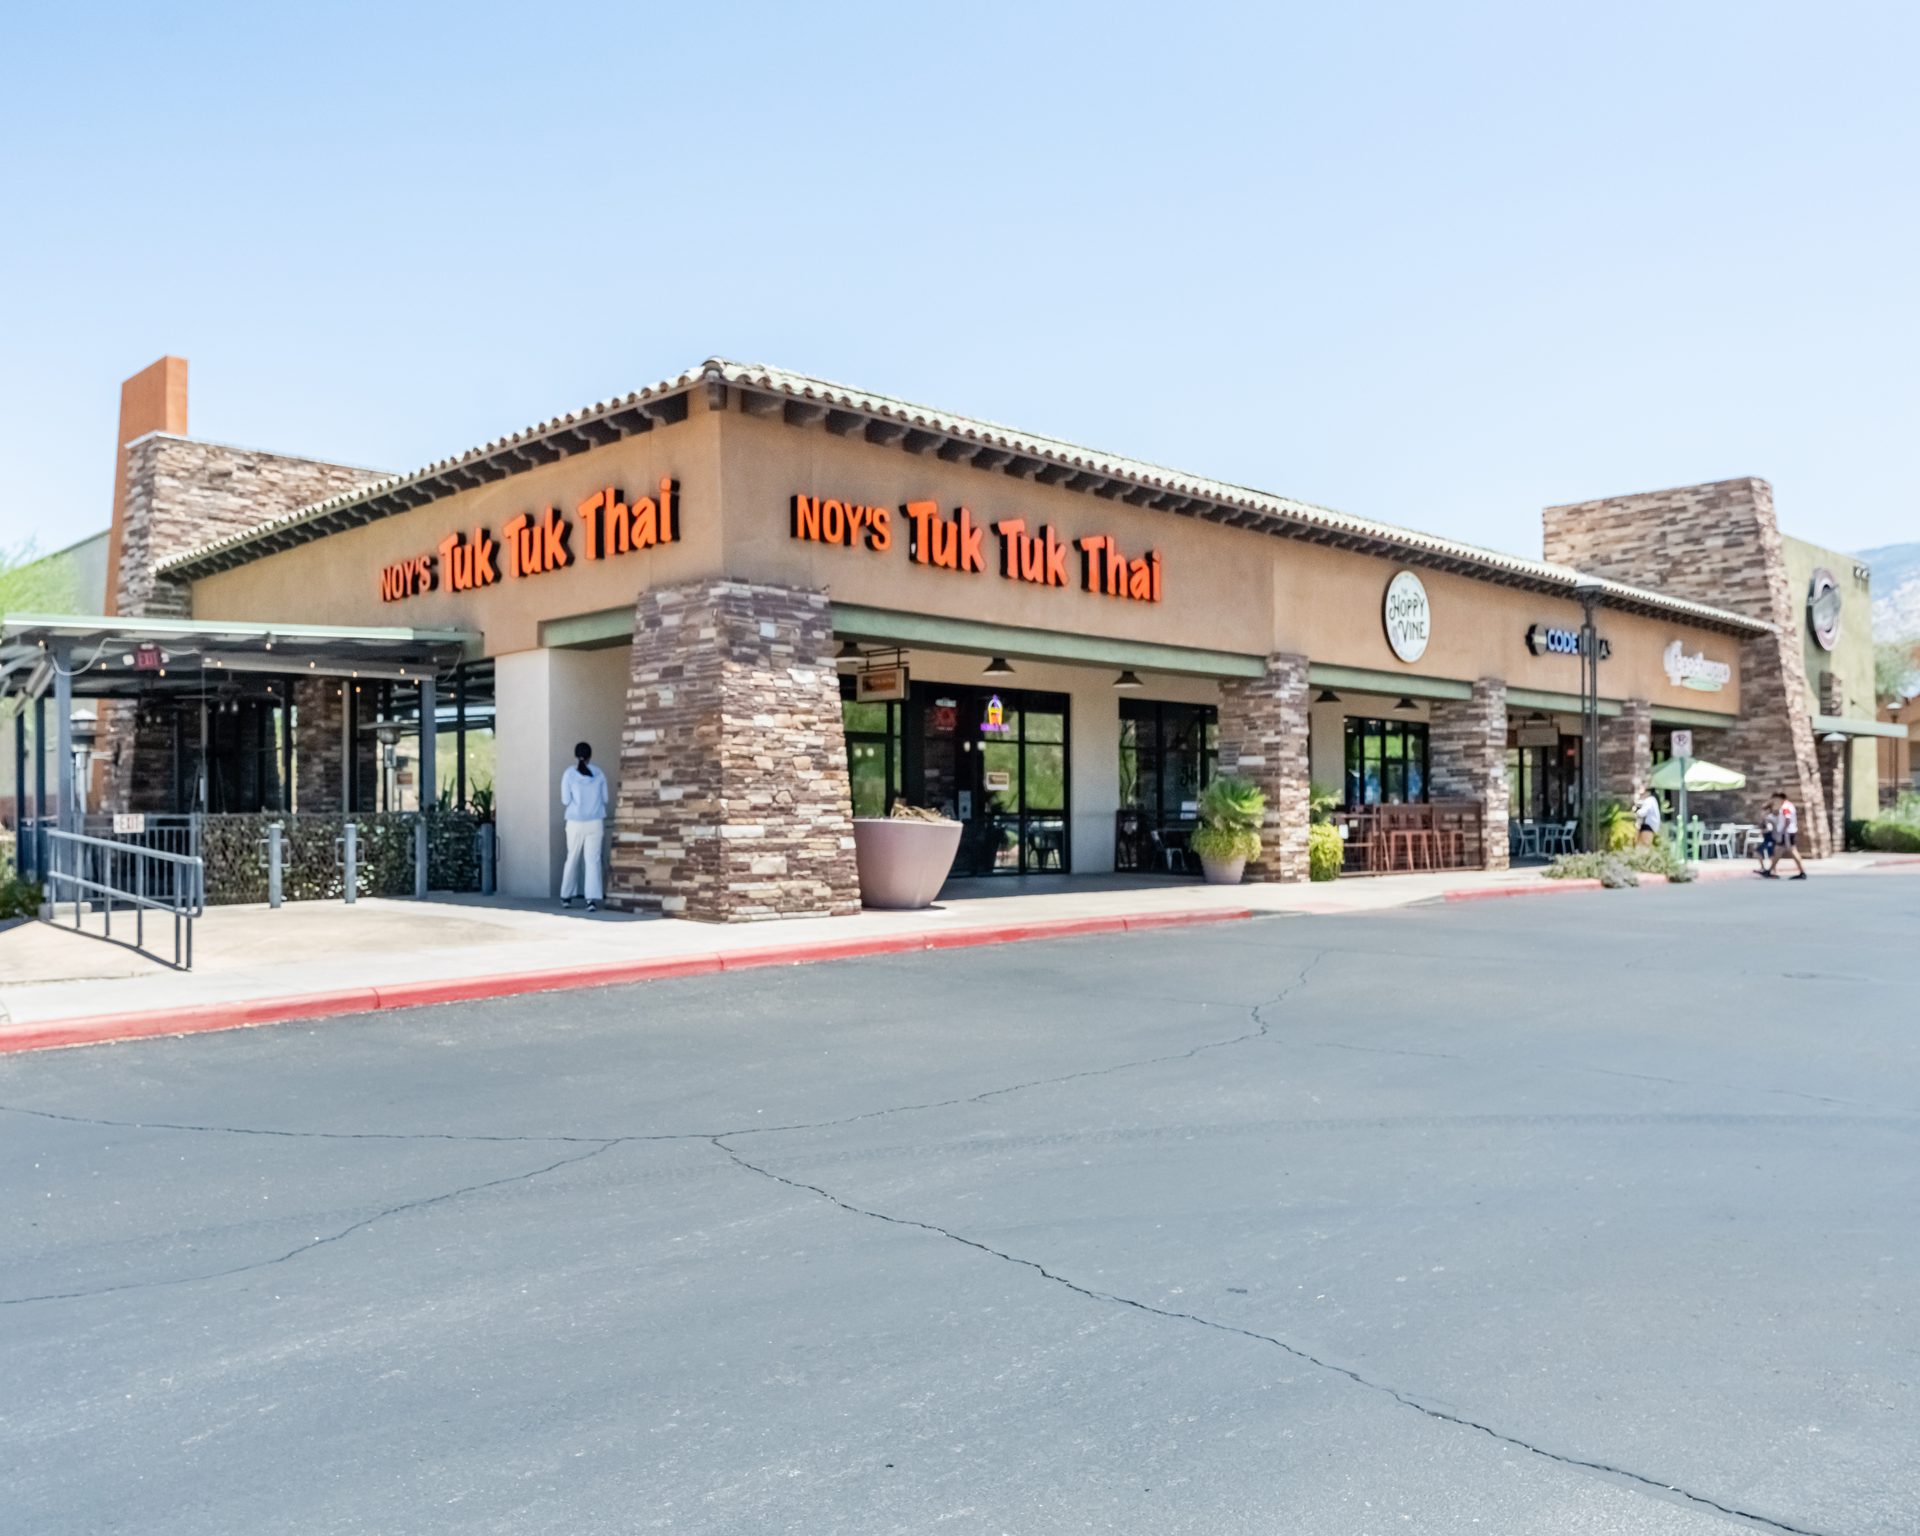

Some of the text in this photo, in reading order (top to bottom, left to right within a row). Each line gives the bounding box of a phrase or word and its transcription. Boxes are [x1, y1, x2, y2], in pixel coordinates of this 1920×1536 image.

[379, 475, 672, 600] NOY'S Tuk Tuk Thai
[796, 494, 1162, 602] NOY'S Tuk Tuk Thai
[1398, 620, 1427, 643] VINE
[1547, 628, 1579, 655] CODE
